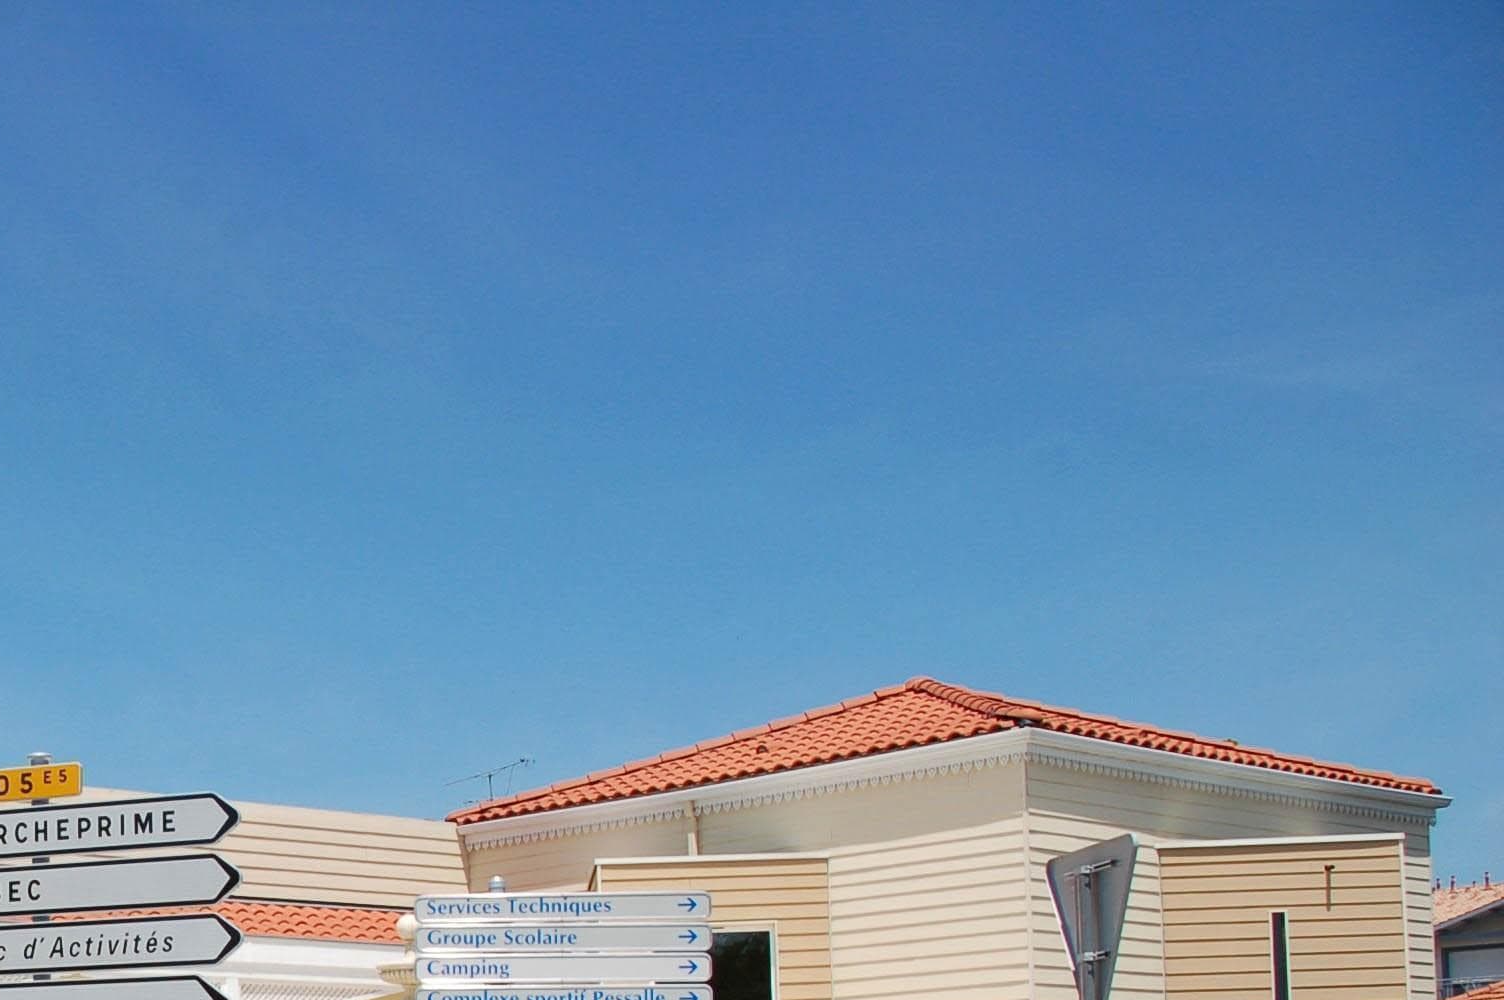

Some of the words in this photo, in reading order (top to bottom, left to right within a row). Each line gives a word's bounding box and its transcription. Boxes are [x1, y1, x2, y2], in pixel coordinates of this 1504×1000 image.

[426, 898, 501, 916] Services
[506, 896, 612, 917] Techniques
[426, 929, 498, 949] Groupe
[503, 928, 578, 946] Scolaire
[426, 959, 511, 979] Camping
